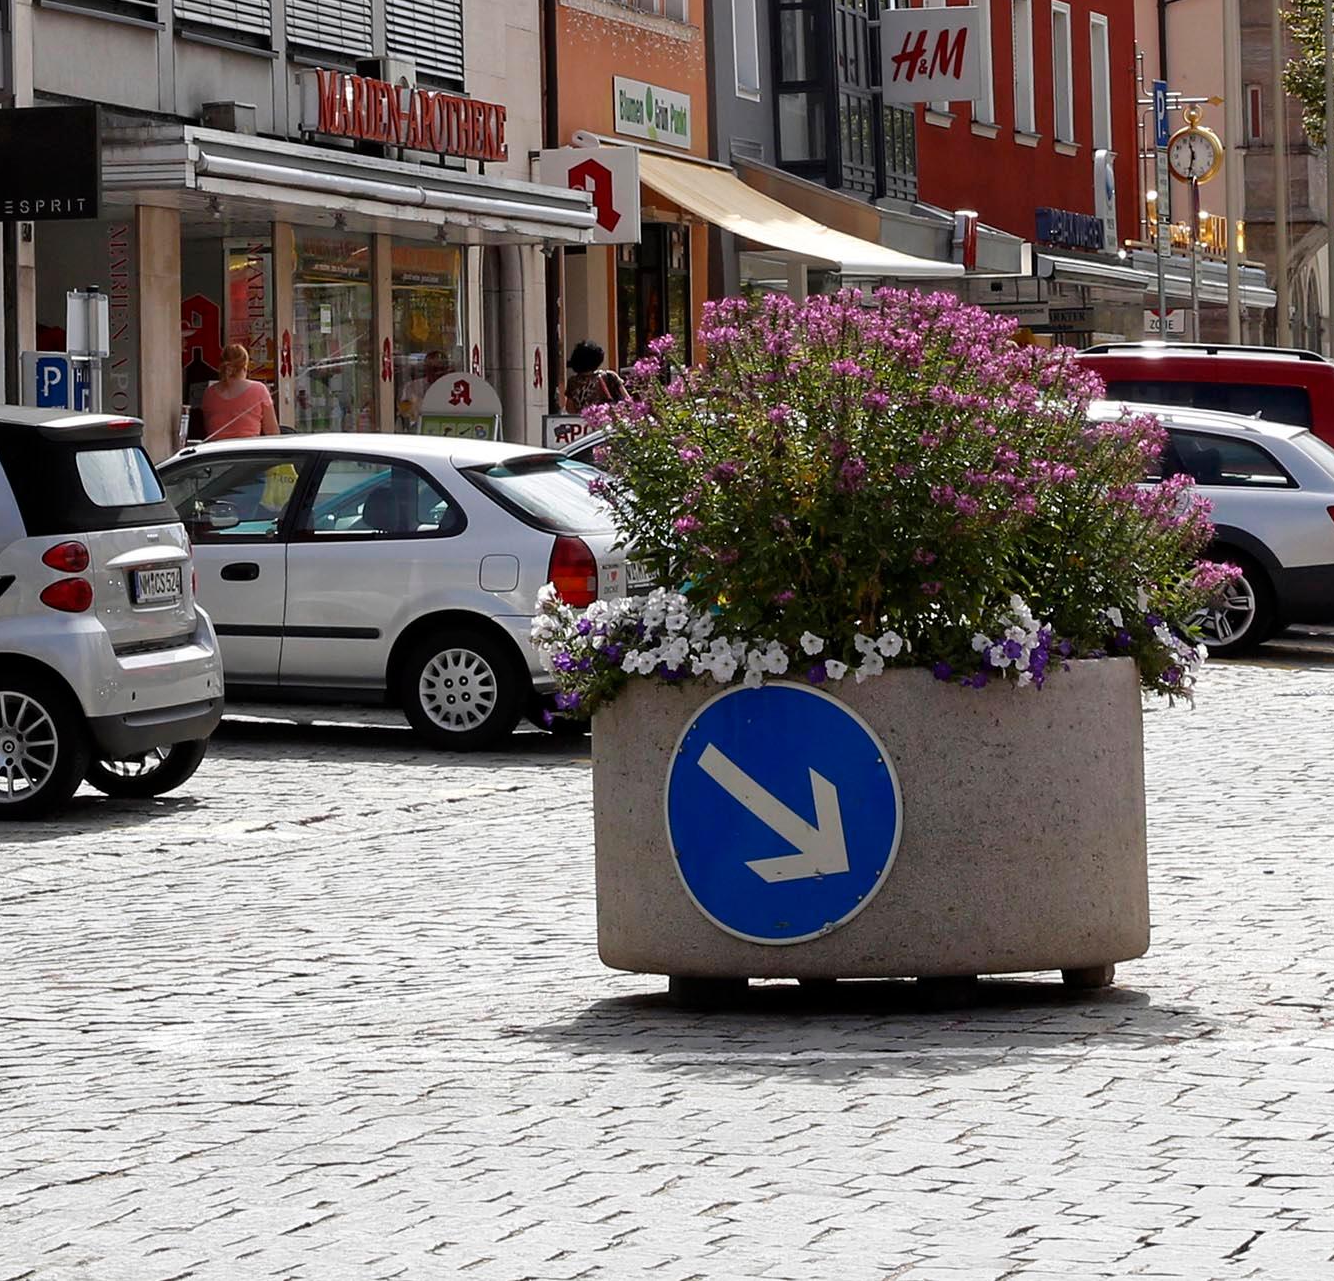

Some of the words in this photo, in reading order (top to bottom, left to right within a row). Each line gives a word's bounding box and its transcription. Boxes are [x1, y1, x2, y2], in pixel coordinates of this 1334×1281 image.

[890, 27, 968, 82] H&M
[316, 67, 509, 163] MARIEN-APOTHEKE
[1156, 89, 1166, 139] P
[4, 198, 87, 214] ESPRIT
[109, 226, 129, 341] MARIEN
[43, 366, 62, 397] P
